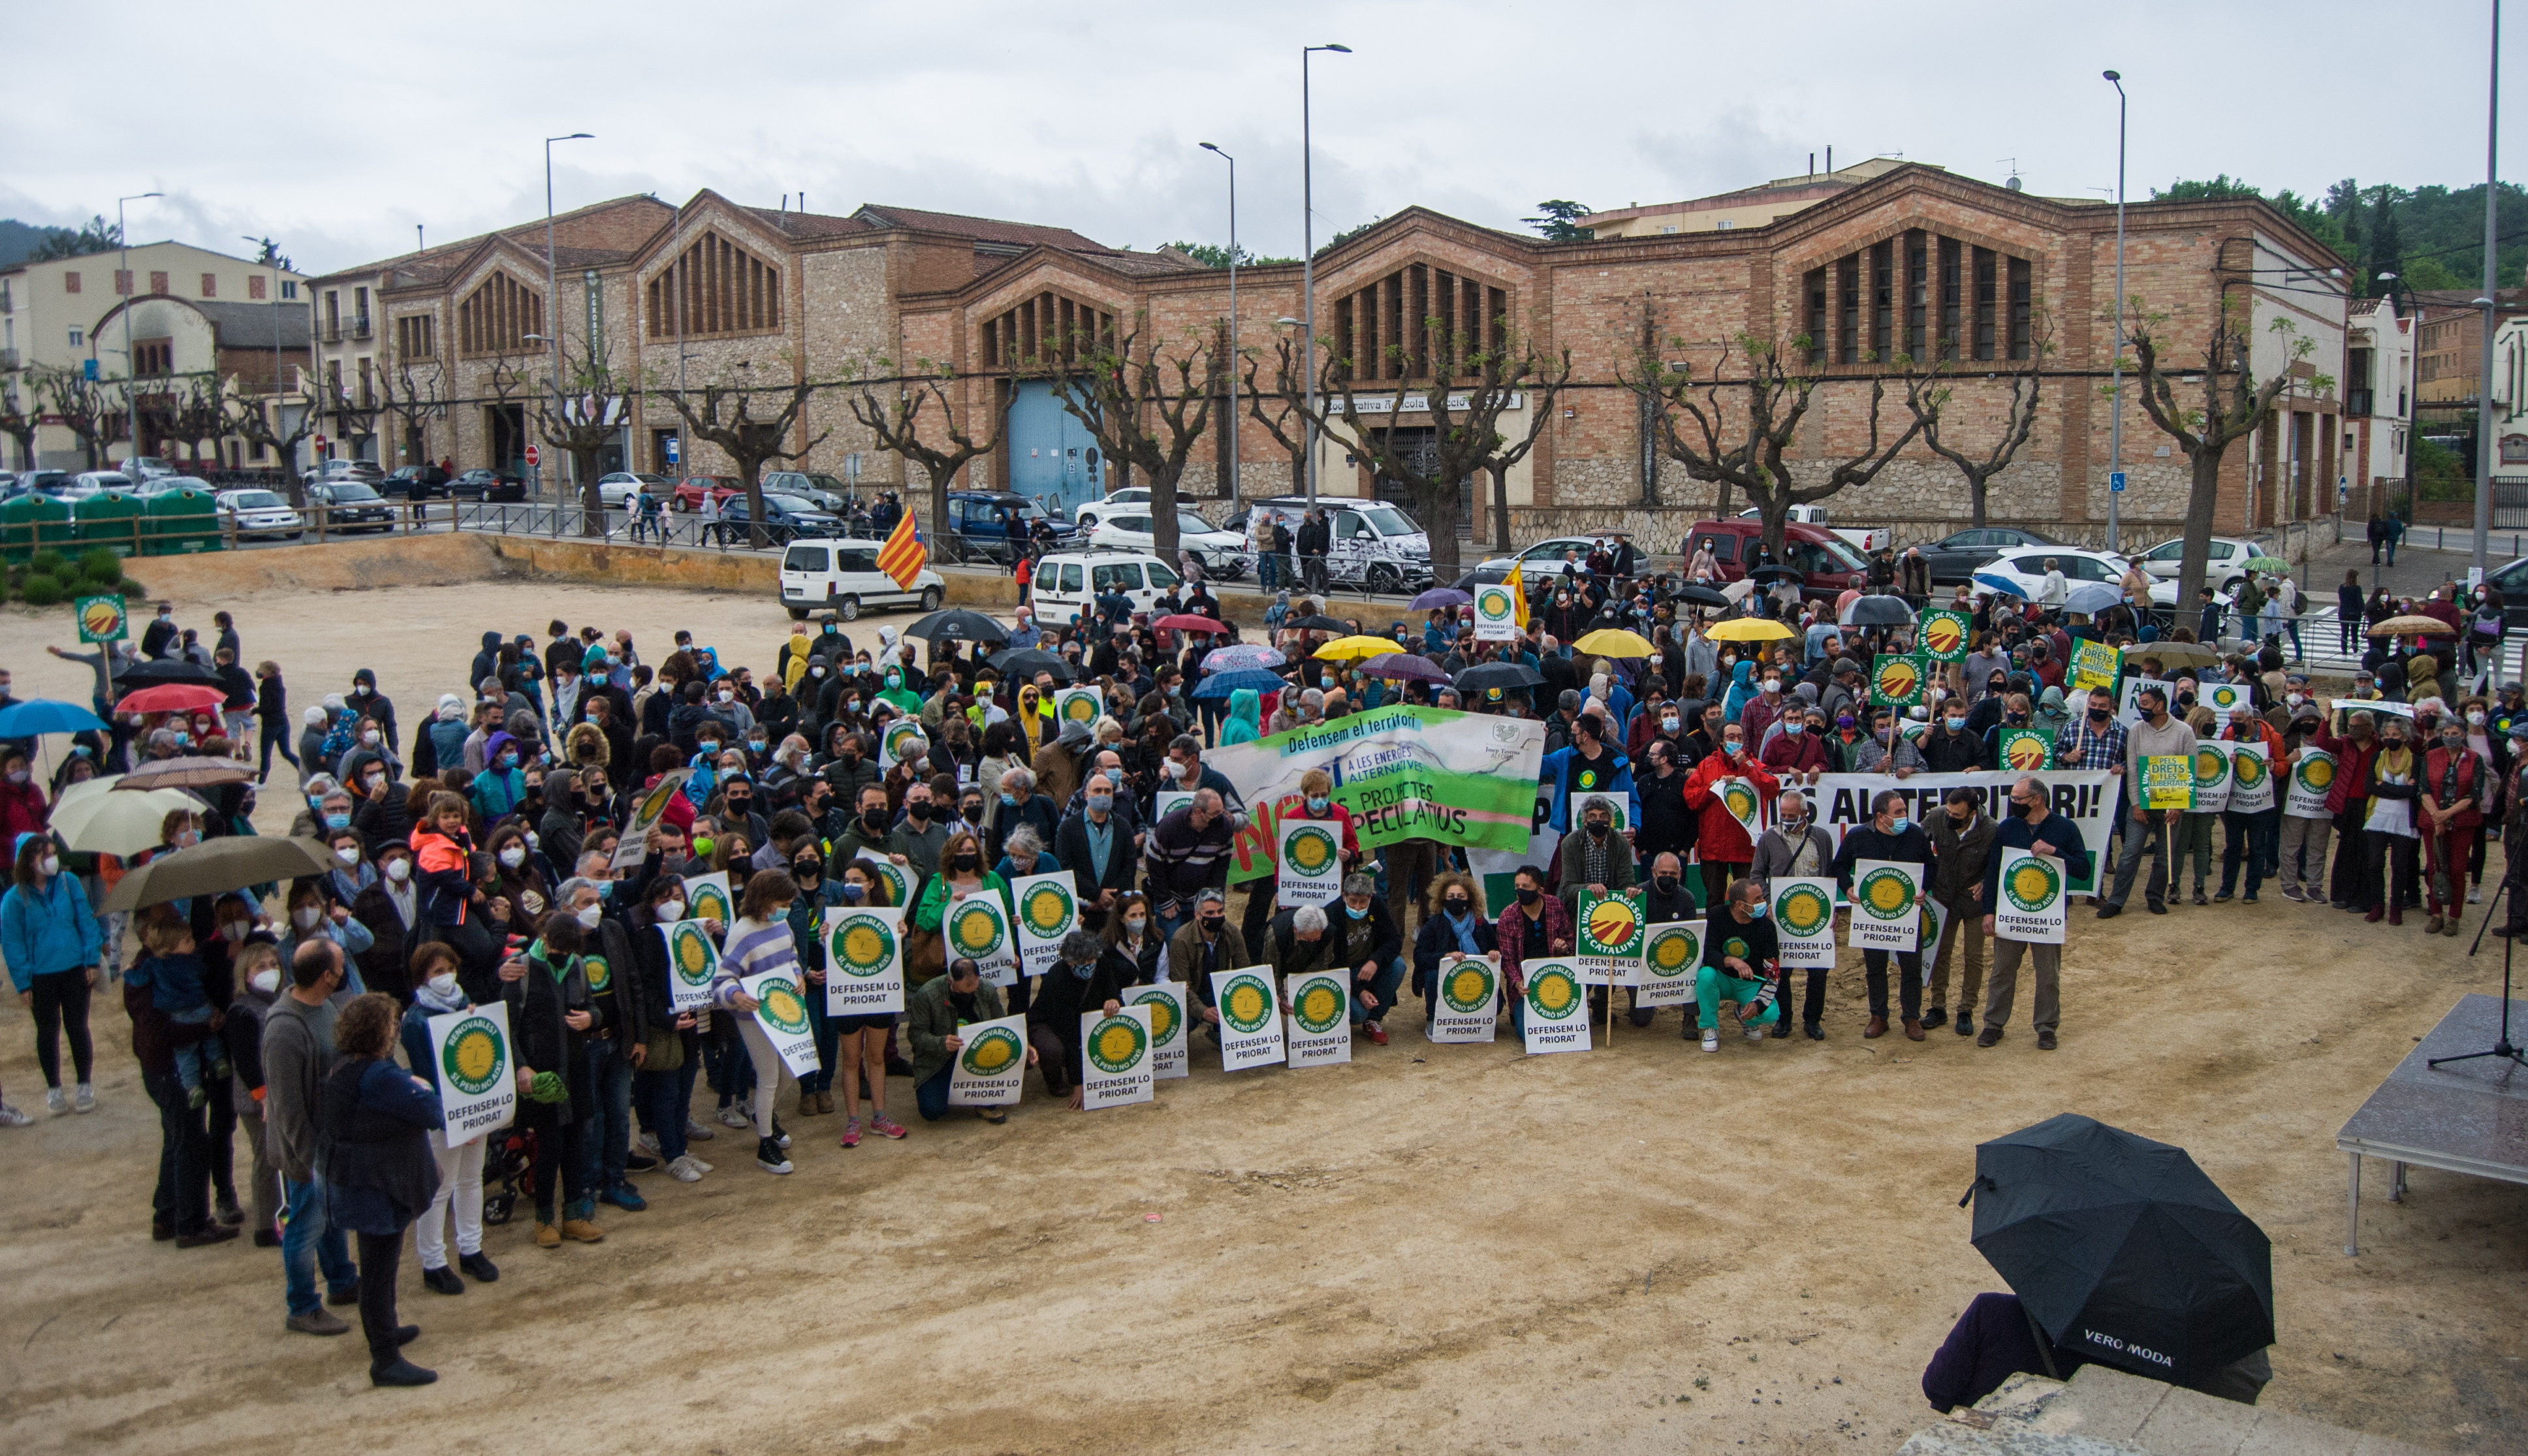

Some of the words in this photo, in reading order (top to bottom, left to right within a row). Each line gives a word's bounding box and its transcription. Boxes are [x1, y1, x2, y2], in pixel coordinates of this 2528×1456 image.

[1921, 616, 1935, 634] UNIÓ
[1934, 611, 1945, 620] DE
[1946, 612, 1967, 639] PAGESOS
[1920, 637, 1928, 647] DE
[1925, 641, 1967, 659] CATALUNYA
[2092, 644, 2108, 653] PELS
[2083, 648, 2114, 663] DRETS
[1874, 662, 1888, 681] UNIÓ
[1899, 657, 1922, 682] PAGESOS
[2093, 659, 2104, 667] LES
[1879, 684, 1921, 704] CATALUNYA
[1289, 728, 1349, 753] Defensem
[1353, 718, 1365, 736] el
[1368, 713, 1415, 733] territori
[2001, 737, 2014, 756] UNIÓ
[2025, 731, 2051, 757] PAGESOS
[1348, 759, 1355, 772] A
[1357, 755, 1372, 769] LES
[1374, 746, 1412, 764] ENERGIES
[2198, 746, 2224, 759] OVABLES?
[1349, 759, 1423, 784] ALTERNATIVES
[2151, 764, 2185, 774] DRETS
[1359, 781, 1433, 811] PROJECTES
[1350, 800, 1467, 836] PECULATIUS
[1289, 827, 1332, 843] RENOVABLES?
[2010, 859, 2055, 874] RENOVABLES?
[1866, 869, 1911, 885] RENOVABLES?
[1024, 882, 1066, 902] RENOVABLES?
[1281, 881, 1325, 890] DEFENSEM
[1781, 885, 1825, 900] RENOVABLES?
[691, 882, 725, 906] RENOVABLES?
[1291, 891, 1327, 900] PRIORAT
[1581, 900, 1597, 925] UNIÓ
[1611, 893, 1643, 926] PAGESOS
[2012, 897, 2030, 910] PERÒ
[953, 902, 996, 923] RENOVABLES?
[1868, 907, 1884, 919] PERÒ
[838, 915, 889, 934] RENOVABLES?
[1999, 914, 2047, 926] DEFENSEM
[674, 921, 705, 941] RENOVABLES?
[1853, 923, 1901, 934] DEFENSEM
[2010, 926, 2049, 935] PRIORAT
[1581, 926, 1592, 941] DE
[1589, 929, 1643, 955] CATALUNYA
[1653, 928, 1694, 945] RENOVABLES?
[1863, 934, 1903, 943] PRIORAT
[981, 947, 992, 956] NO
[1024, 943, 1062, 957] DEFENSE
[844, 962, 864, 975] PERÒ
[865, 966, 877, 975] NO
[1000, 958, 1012, 967] LO
[1449, 962, 1491, 977] RENOVABLES?
[1532, 966, 1575, 983] RENOVABLES?
[830, 983, 884, 994] DEFENSEM
[887, 982, 900, 990] LO
[1224, 975, 1265, 996] RENOVABLES?
[1299, 979, 1340, 998] RENOVABLES?
[1640, 981, 1684, 992] DEFENSEM
[675, 990, 712, 1003] DEFENSE
[844, 994, 887, 1005] PRIORAT
[1650, 989, 1685, 999] PRIORAT
[1538, 1008, 1556, 1019] PERÒ
[1094, 1017, 1140, 1036] RENOVABLES?
[1233, 1021, 1250, 1032] PERÒ
[1320, 1023, 1331, 1032] NO
[1436, 1017, 1481, 1026] DEFENSEM
[448, 1019, 498, 1046] RENOVABLES?
[1446, 1026, 1482, 1035] PRIORAT
[1528, 1025, 1574, 1035] DEFENSEM
[971, 1029, 1016, 1050] RENOVABLES?
[1225, 1037, 1268, 1051] DEFENSEM
[1270, 1034, 1280, 1043] LO
[1291, 1037, 1335, 1049] DEFENSEM
[1337, 1036, 1348, 1044] LO
[1540, 1034, 1576, 1044] PRIORAT
[1173, 1050, 1184, 1058] LO
[1236, 1047, 1271, 1060] PRIORAT
[1302, 1047, 1338, 1058] PRIORAT
[459, 1079, 481, 1092] PERÒ
[481, 1079, 492, 1090] NO
[953, 1079, 1005, 1089] DEFENSEM
[1086, 1077, 1137, 1090] DEFENSEM
[1138, 1075, 1150, 1083] LO
[964, 1089, 1005, 1098] PRIORAT
[1099, 1086, 1139, 1099] PRIORAT
[448, 1097, 499, 1121] DEFENSEM
[501, 1093, 513, 1105] LO
[463, 1110, 502, 1130] PRIORAT
[2085, 1329, 2123, 1350] VERO
[2126, 1343, 2172, 1367] MODA
